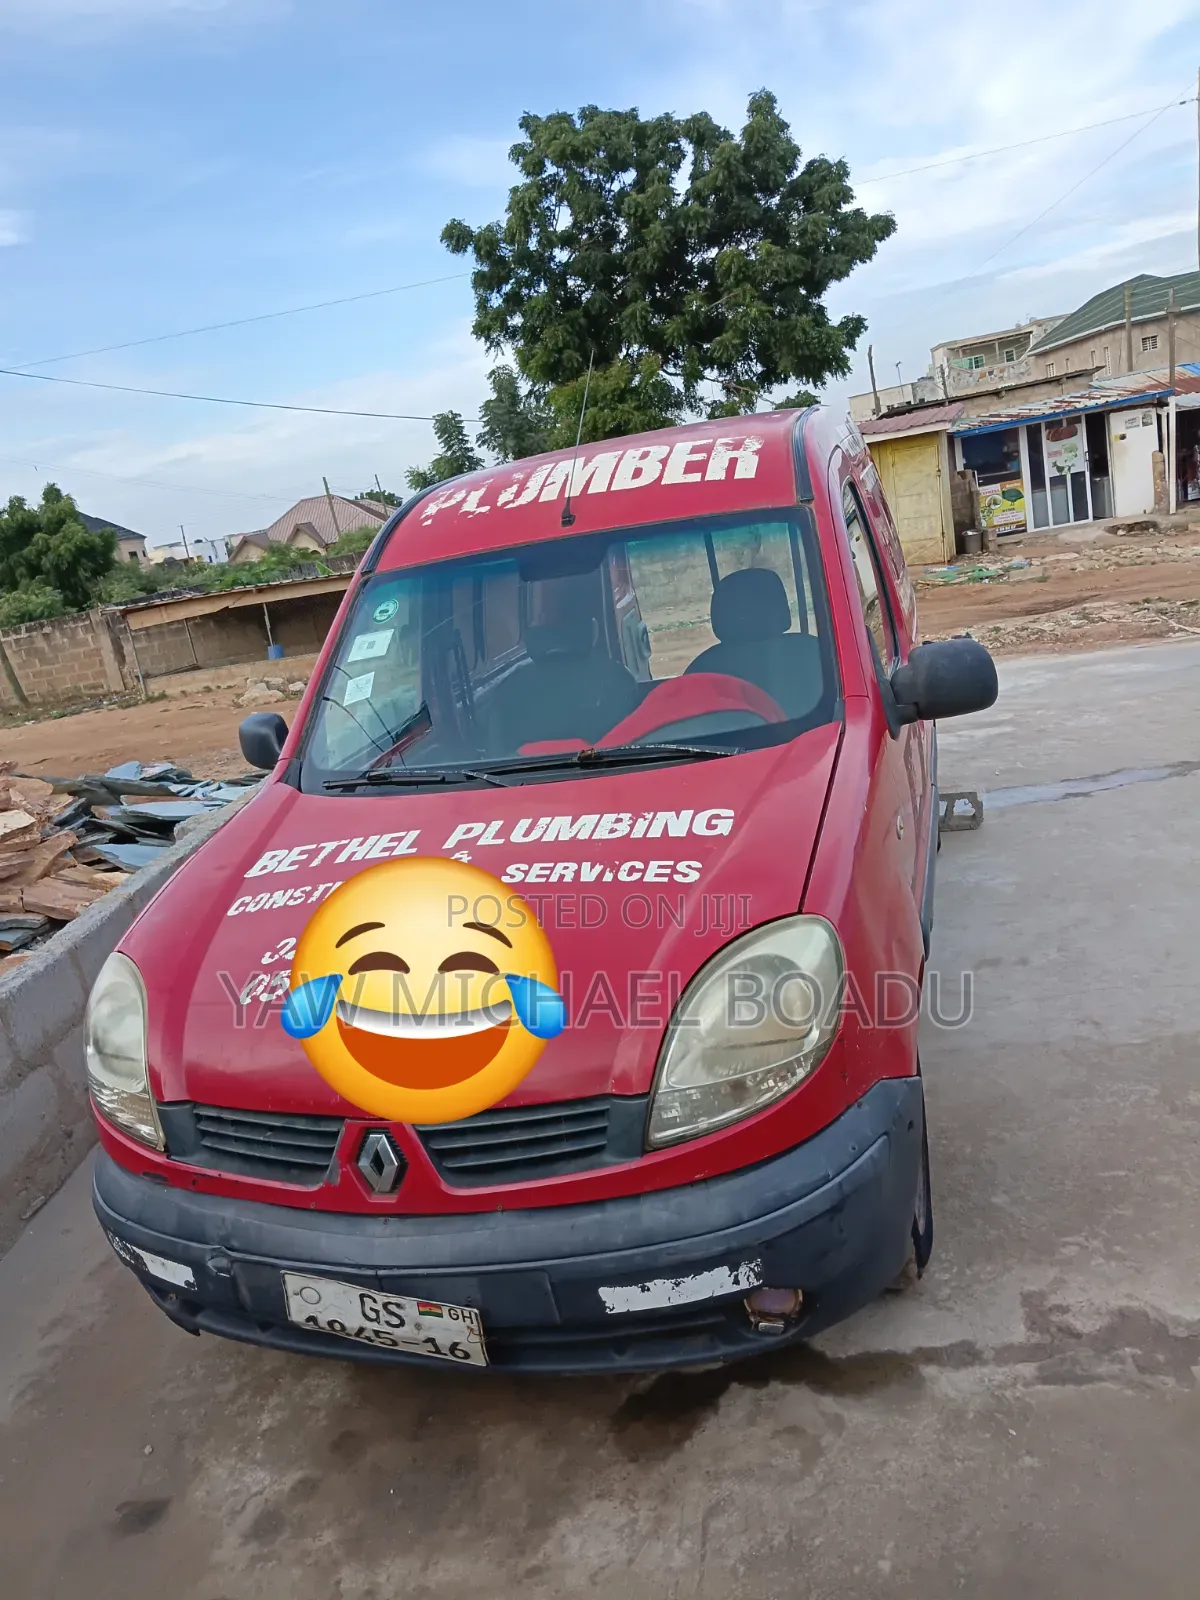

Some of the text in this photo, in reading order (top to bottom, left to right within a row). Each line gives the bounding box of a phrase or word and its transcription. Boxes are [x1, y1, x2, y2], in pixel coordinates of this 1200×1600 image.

[420, 435, 765, 526] PLUMBER
[243, 808, 735, 878] BETHEL PLUMBING
[501, 860, 703, 883] SERVICES
[359, 1293, 474, 1329] GS GH
